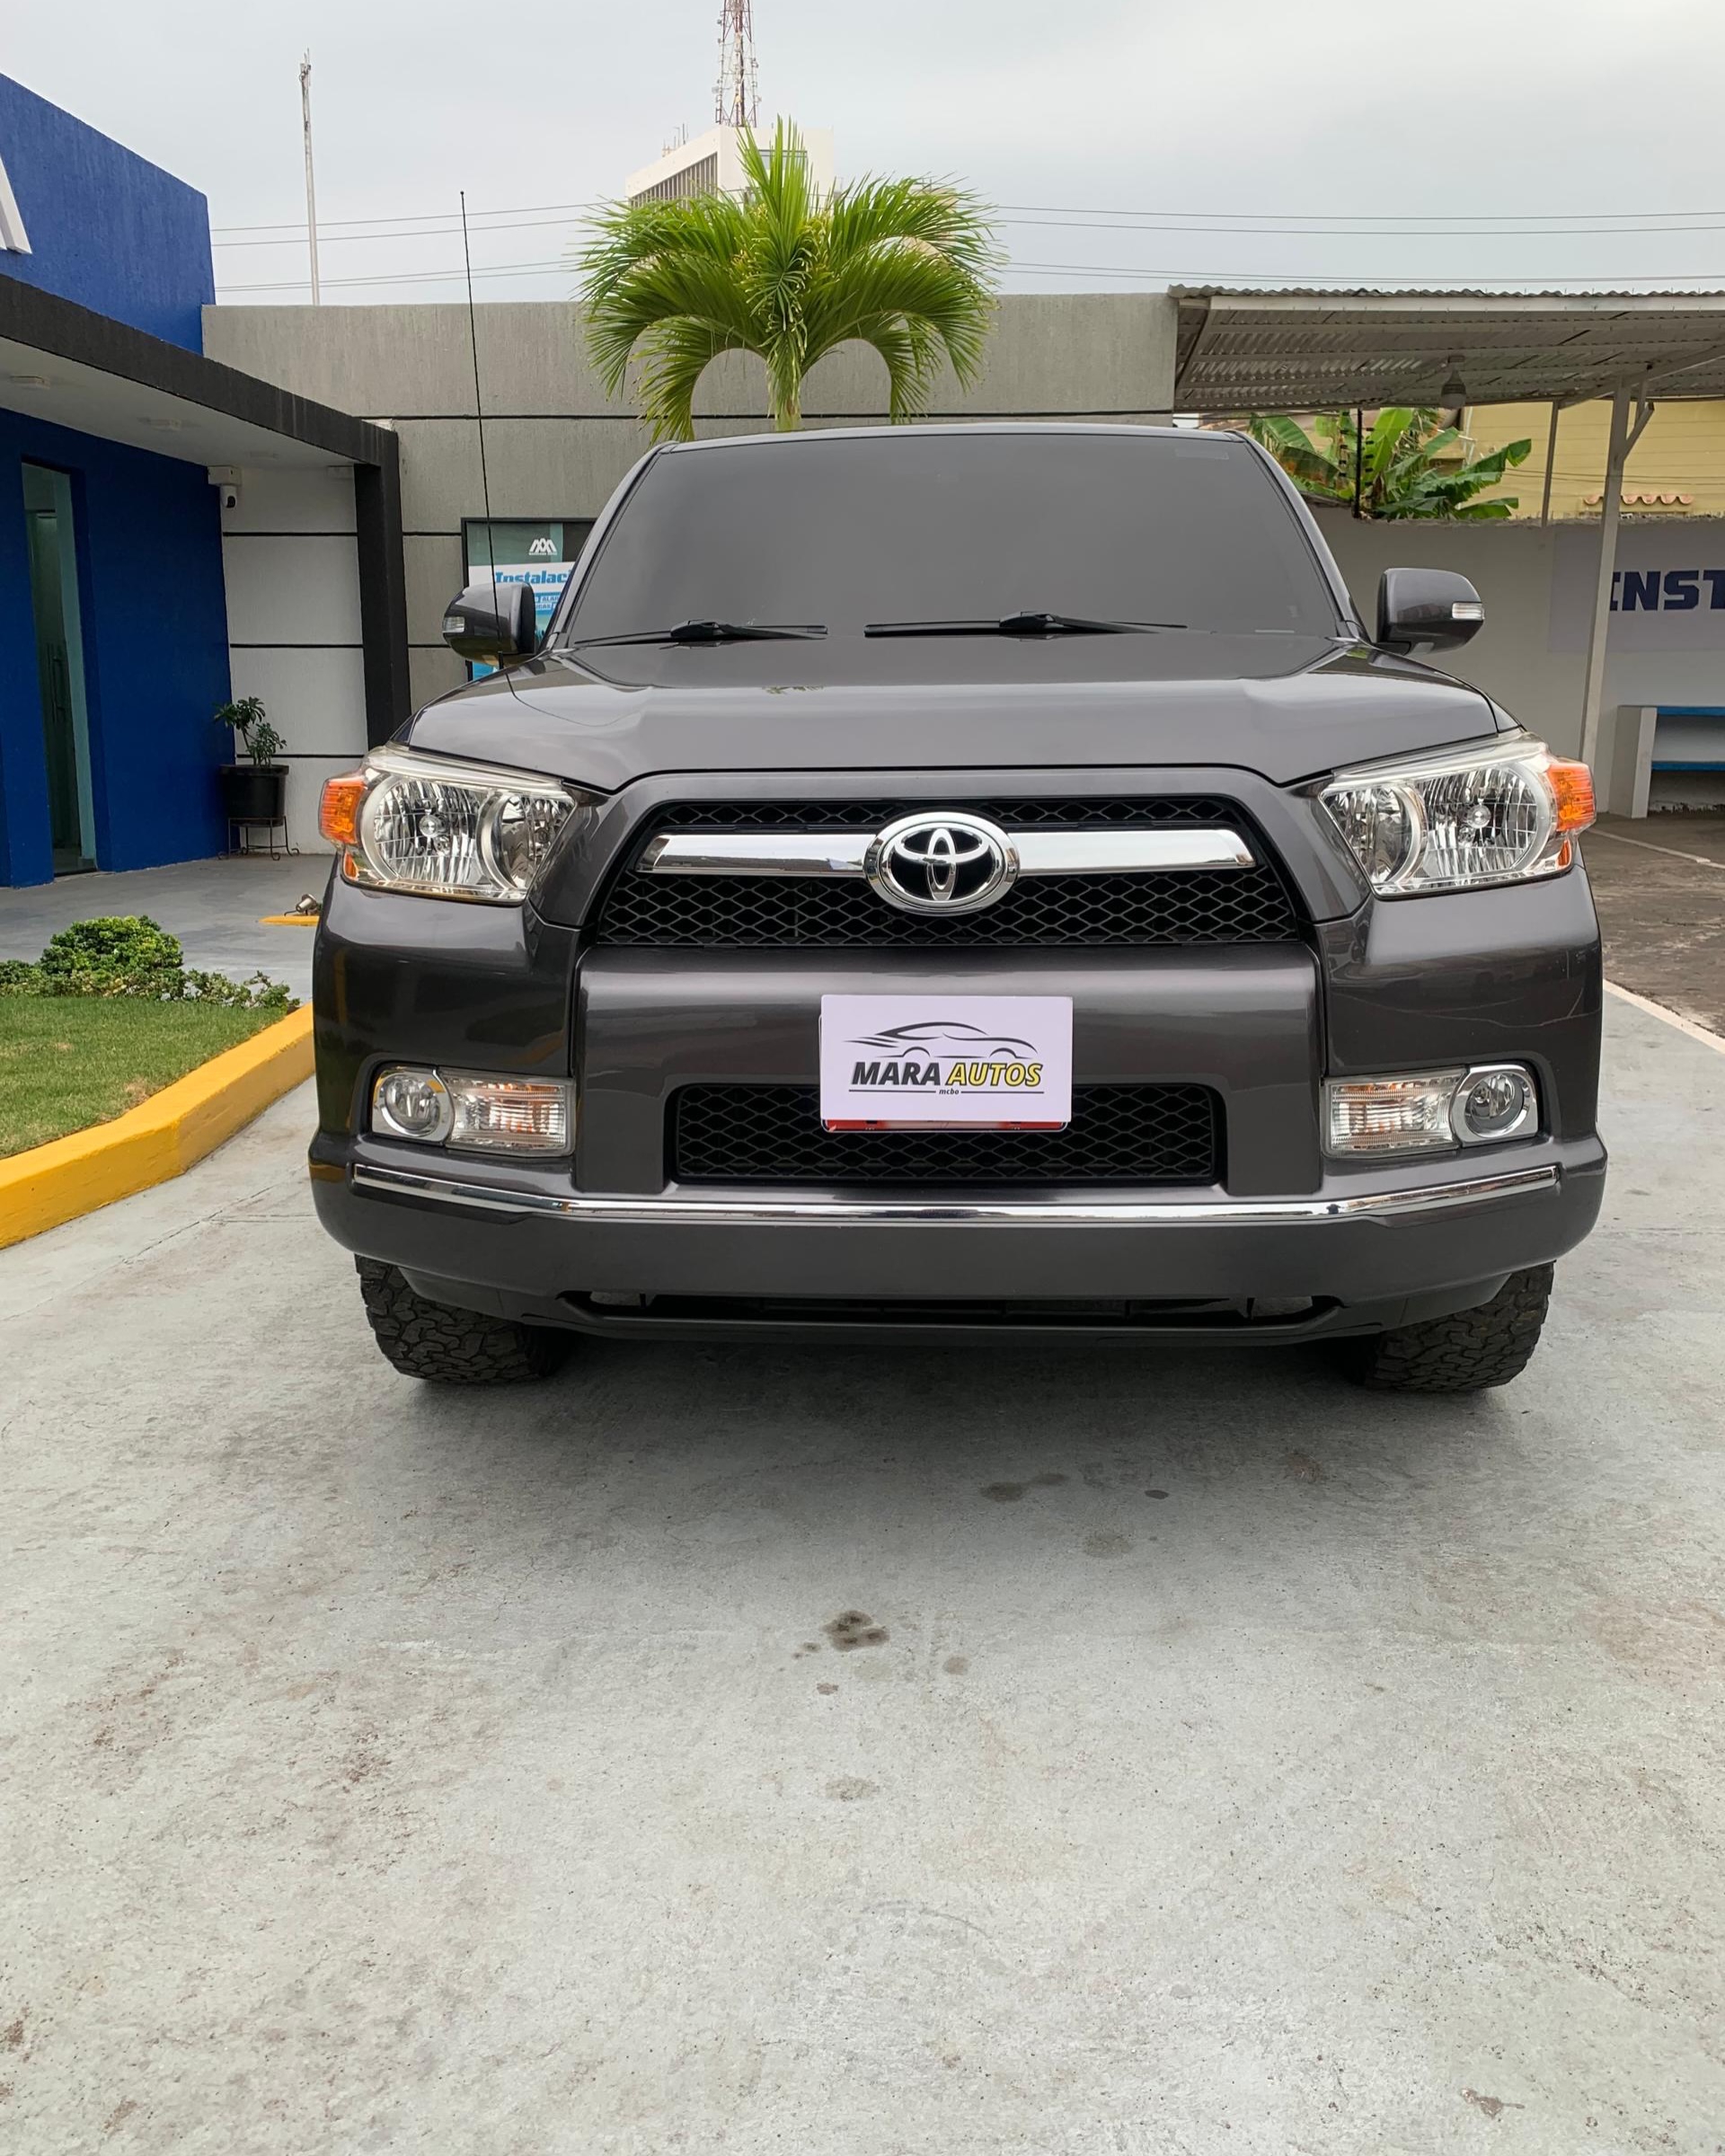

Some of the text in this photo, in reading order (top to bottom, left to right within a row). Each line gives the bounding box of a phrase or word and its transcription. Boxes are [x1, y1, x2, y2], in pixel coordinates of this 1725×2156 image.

[495, 570, 571, 584] Instalac
[852, 1062, 1042, 1086] MARA AUTOS
